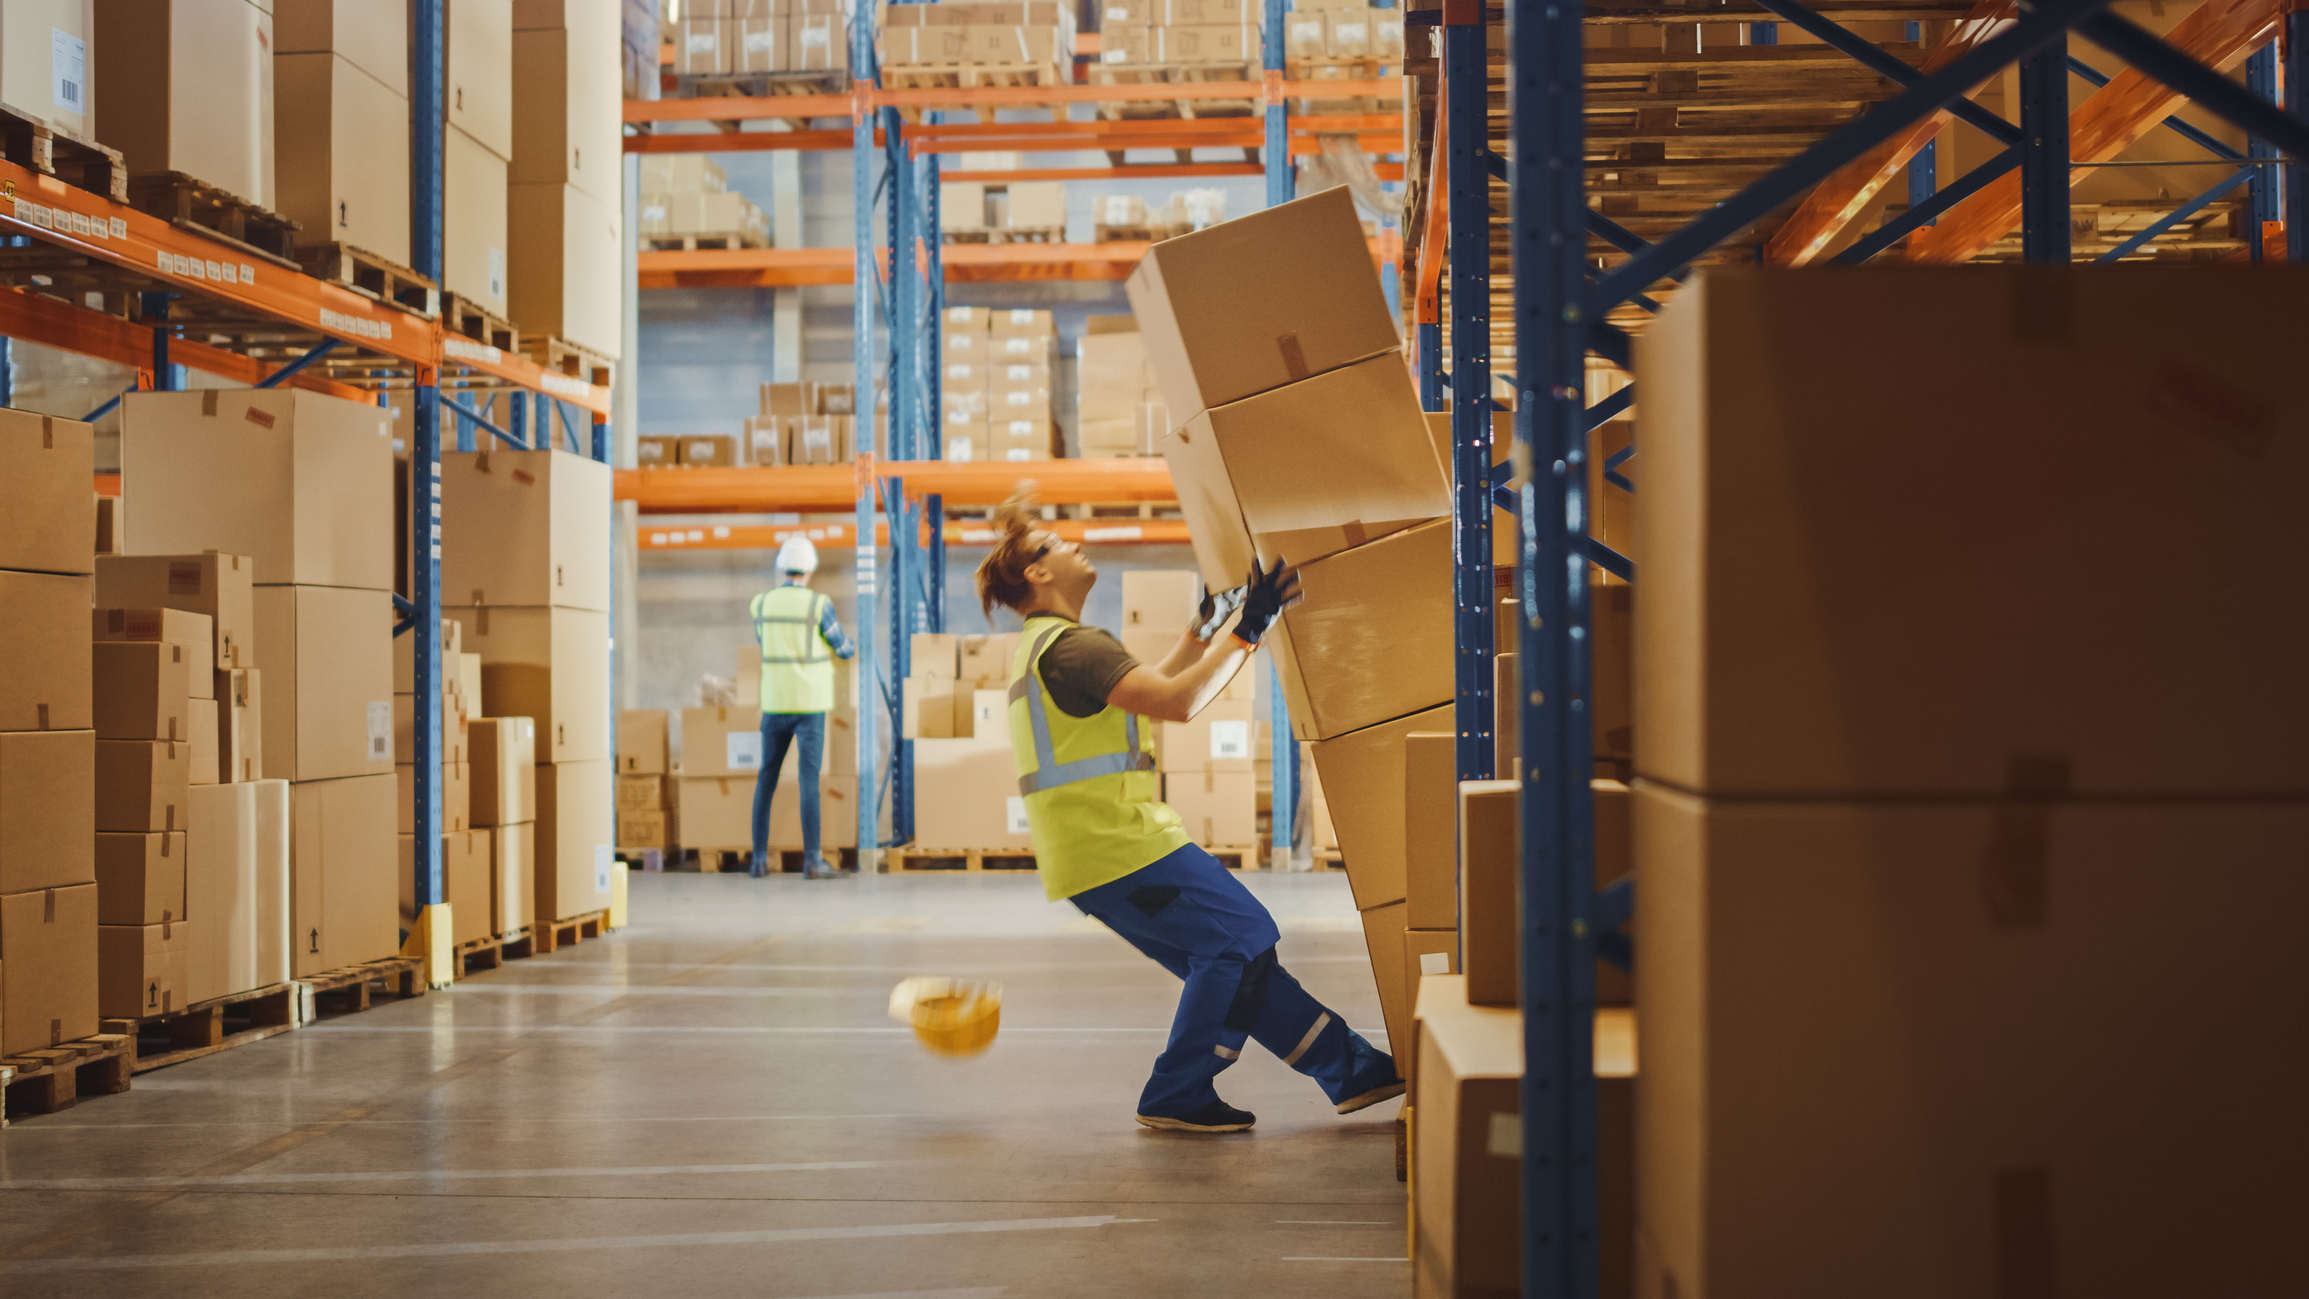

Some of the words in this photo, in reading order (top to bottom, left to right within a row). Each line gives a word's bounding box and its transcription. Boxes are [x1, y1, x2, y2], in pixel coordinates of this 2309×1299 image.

[5, 186, 14, 197] 43
[249, 408, 272, 424] FRAGILE
[171, 571, 198, 581] FRAGILE
[128, 623, 156, 633] FRAGILE
